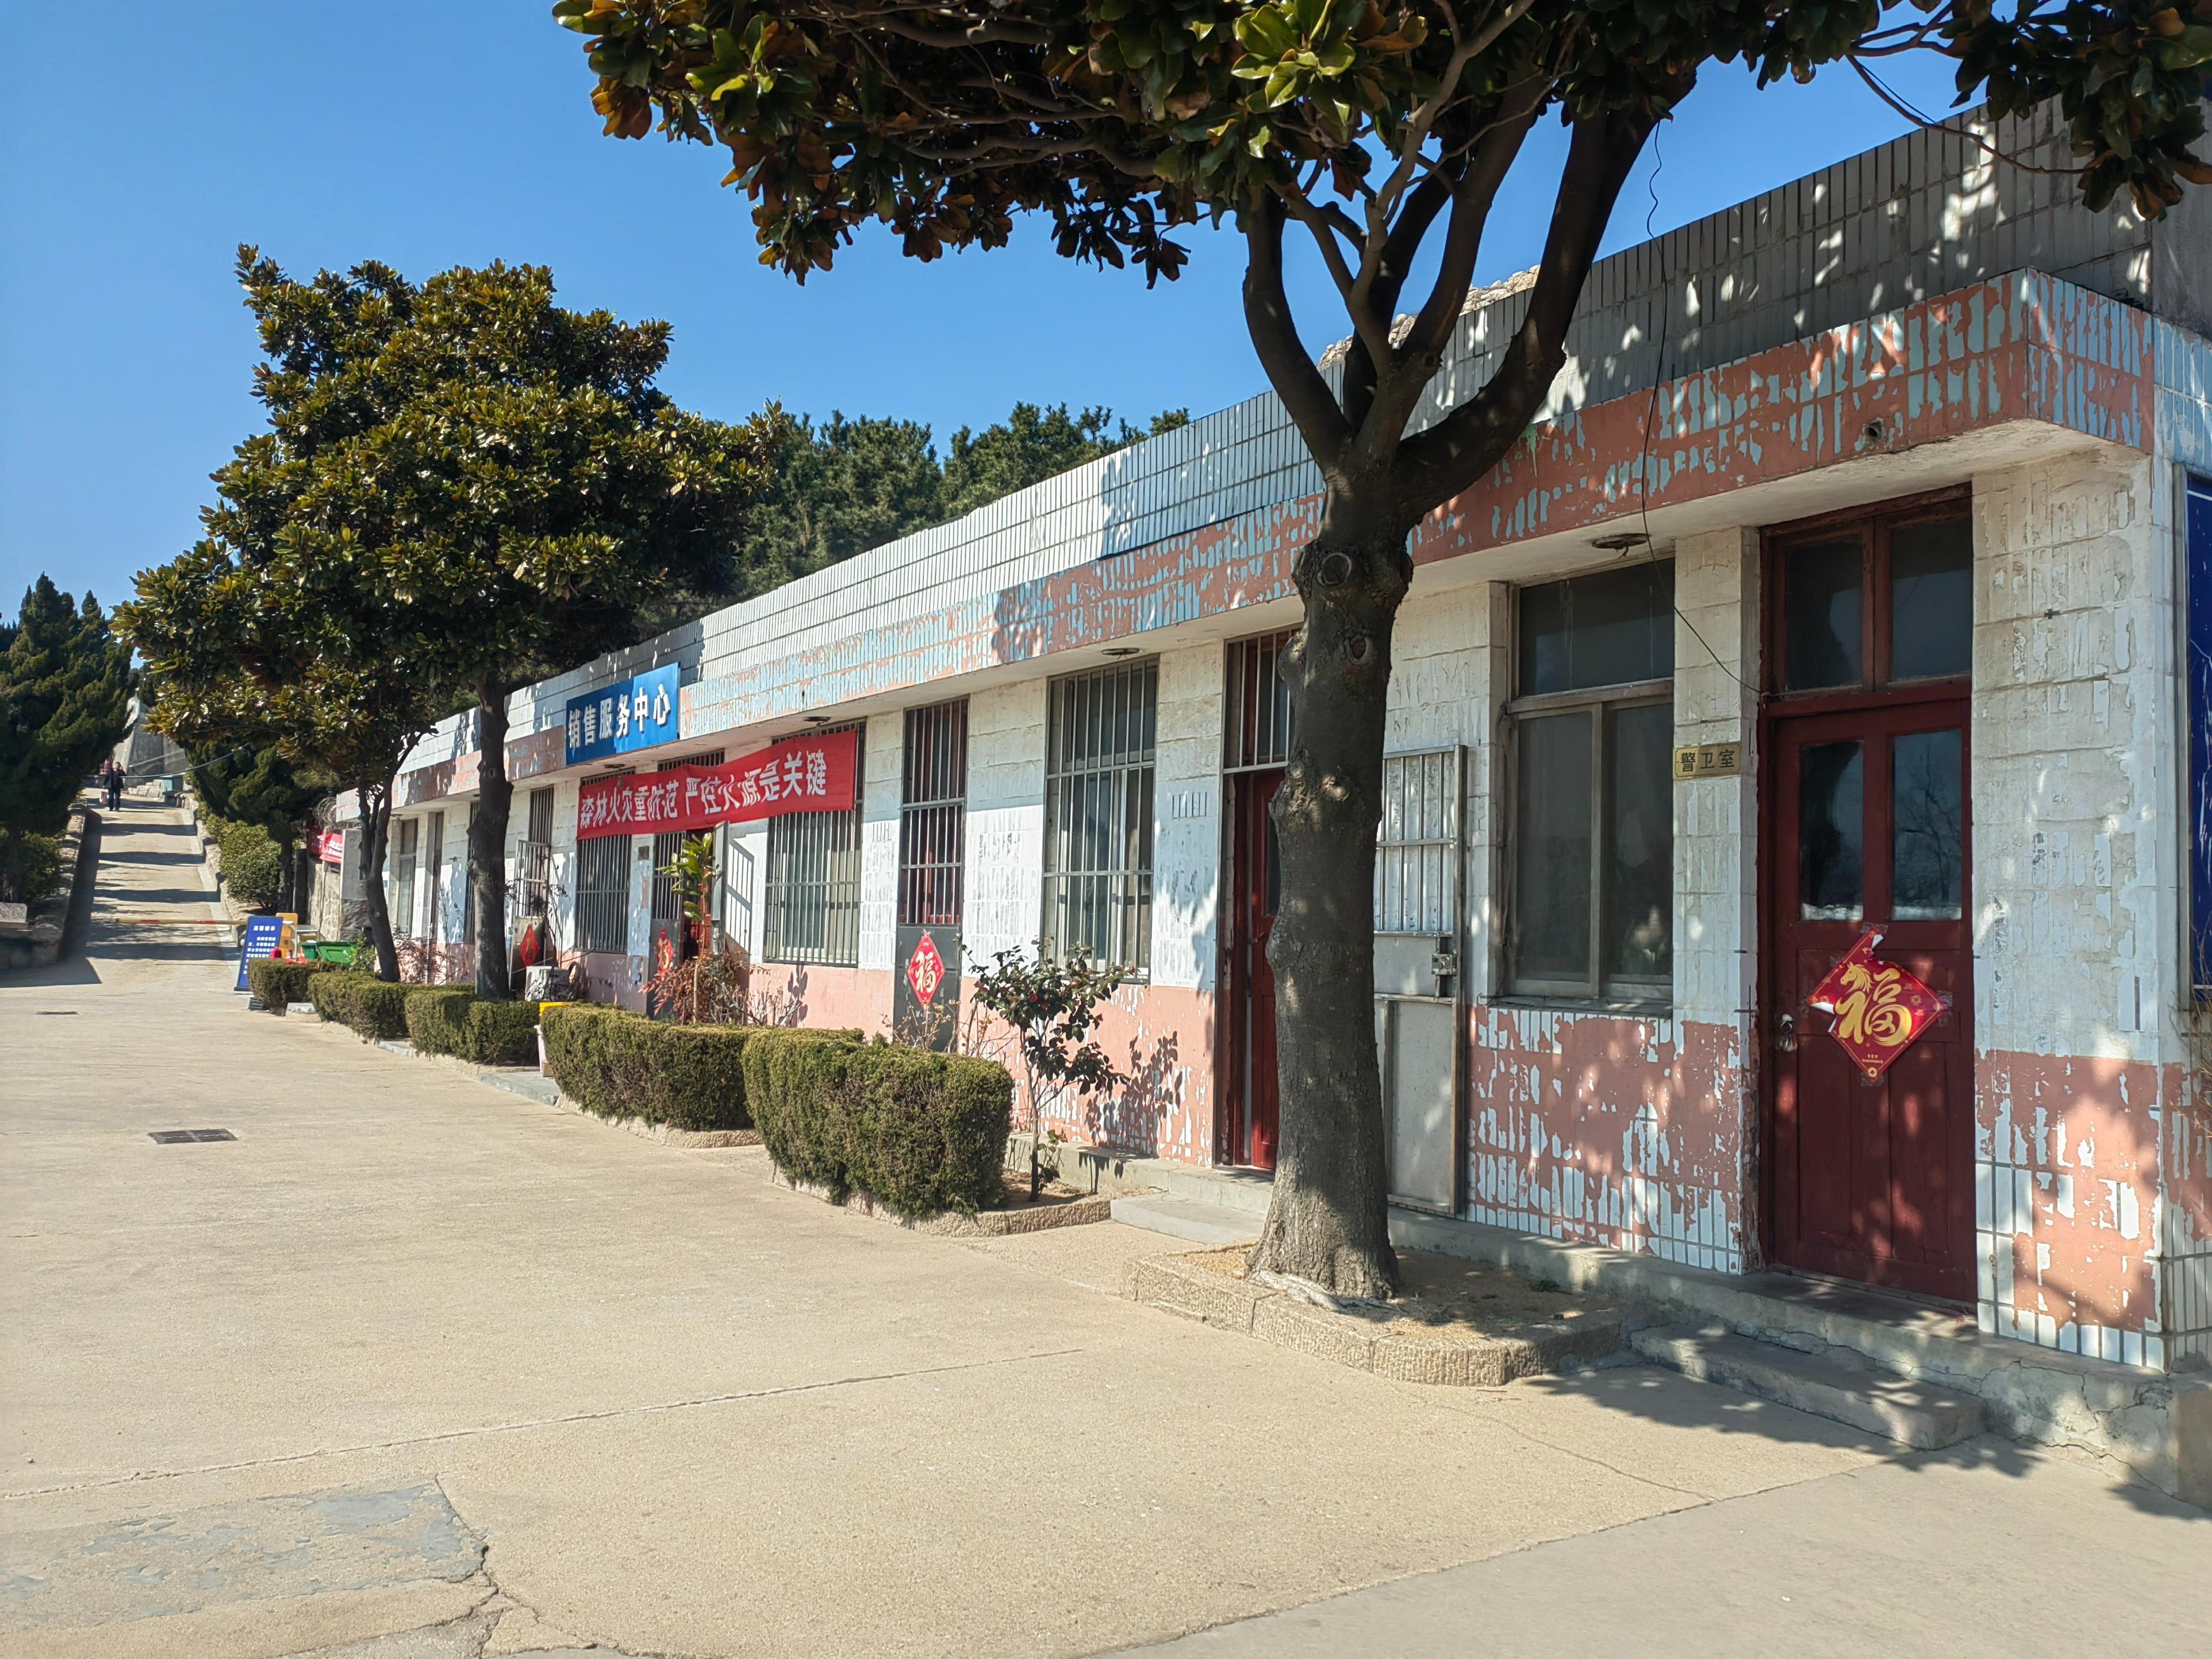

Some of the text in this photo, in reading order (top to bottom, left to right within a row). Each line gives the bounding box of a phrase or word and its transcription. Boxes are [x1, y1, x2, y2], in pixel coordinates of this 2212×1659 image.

[569, 684, 671, 748] 销售服务中心
[581, 749, 826, 829] 森林火灾重防范 严控火源是关键
[1681, 749, 1735, 772] 警卫室
[915, 950, 936, 993] 福
[1835, 961, 1912, 1047] 福
